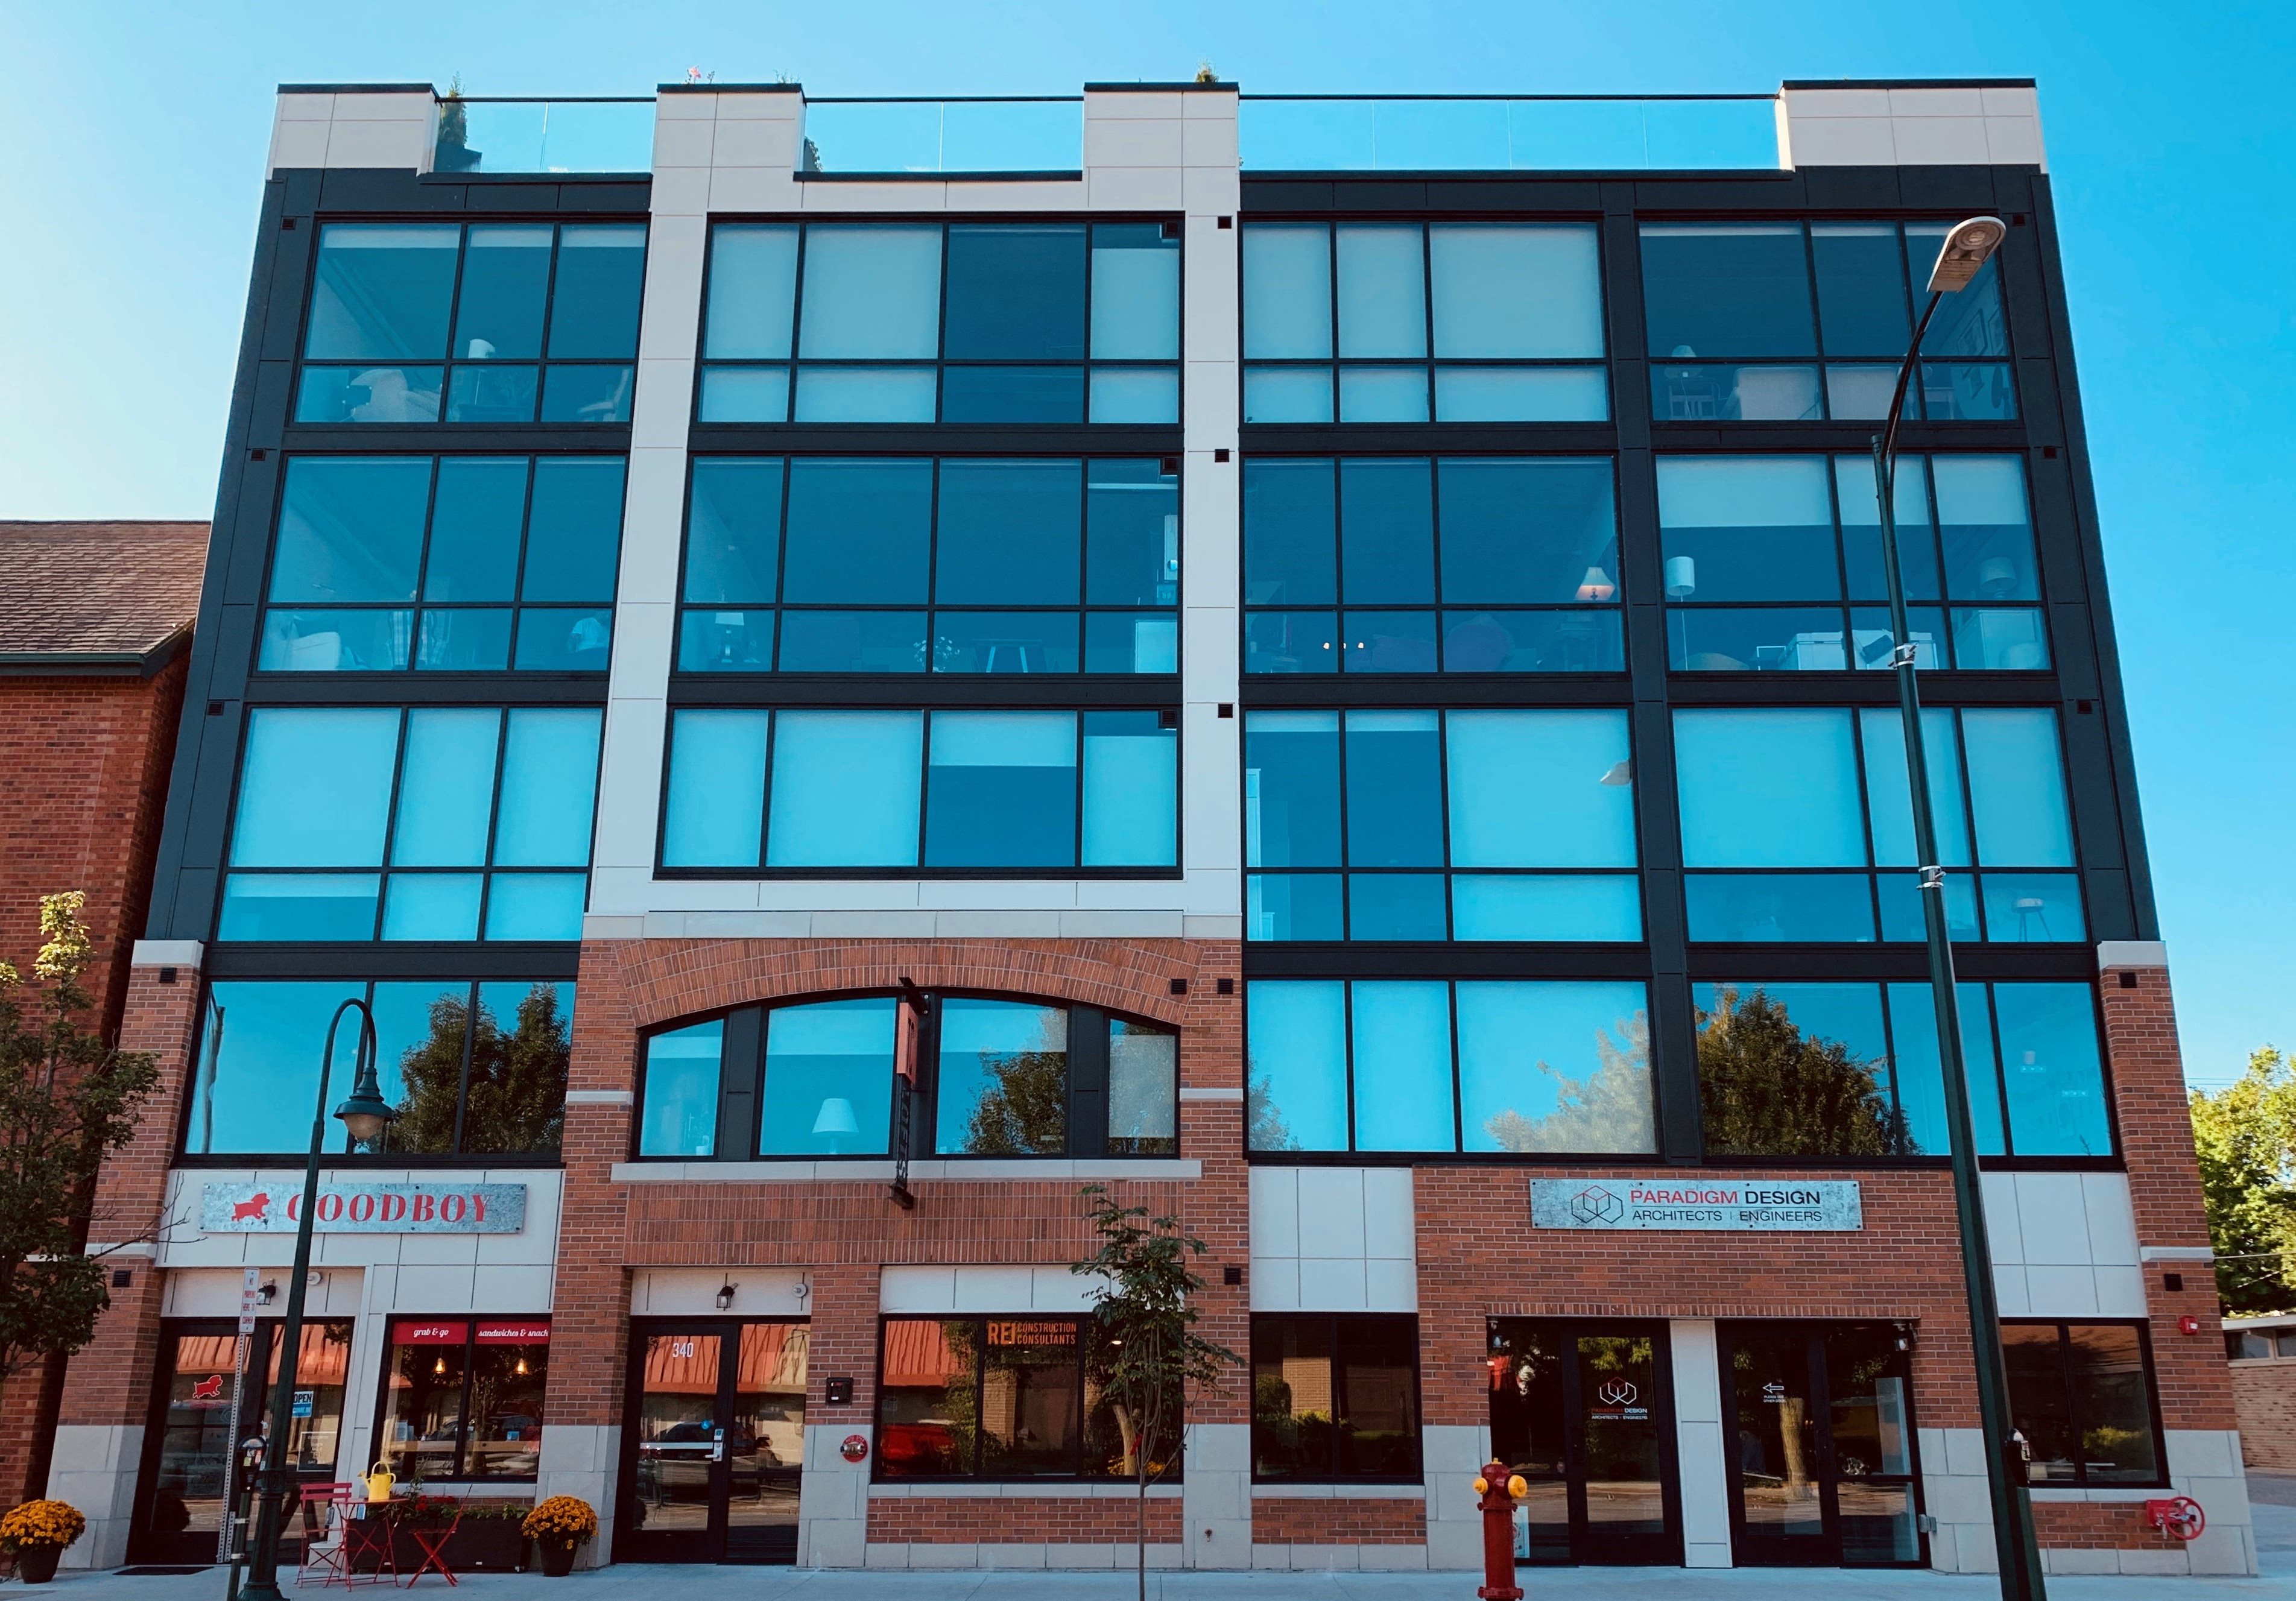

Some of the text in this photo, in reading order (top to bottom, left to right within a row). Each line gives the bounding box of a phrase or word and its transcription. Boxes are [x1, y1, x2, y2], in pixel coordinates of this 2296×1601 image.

[1630, 1190, 1820, 1205] PARADIGM DESIGN
[1632, 1210, 1823, 1222] ARCHITECTS ENGINEERS
[414, 1327, 449, 1337] grab & go
[478, 1328, 519, 1337] sandwiches
[520, 1328, 527, 1337] &
[1017, 1322, 1077, 1333] CONSTRUCTION
[988, 1322, 1016, 1345] REI
[1017, 1334, 1075, 1345] CONSULTANTS
[672, 1342, 694, 1358] 340
[294, 1394, 312, 1404] OPEN
